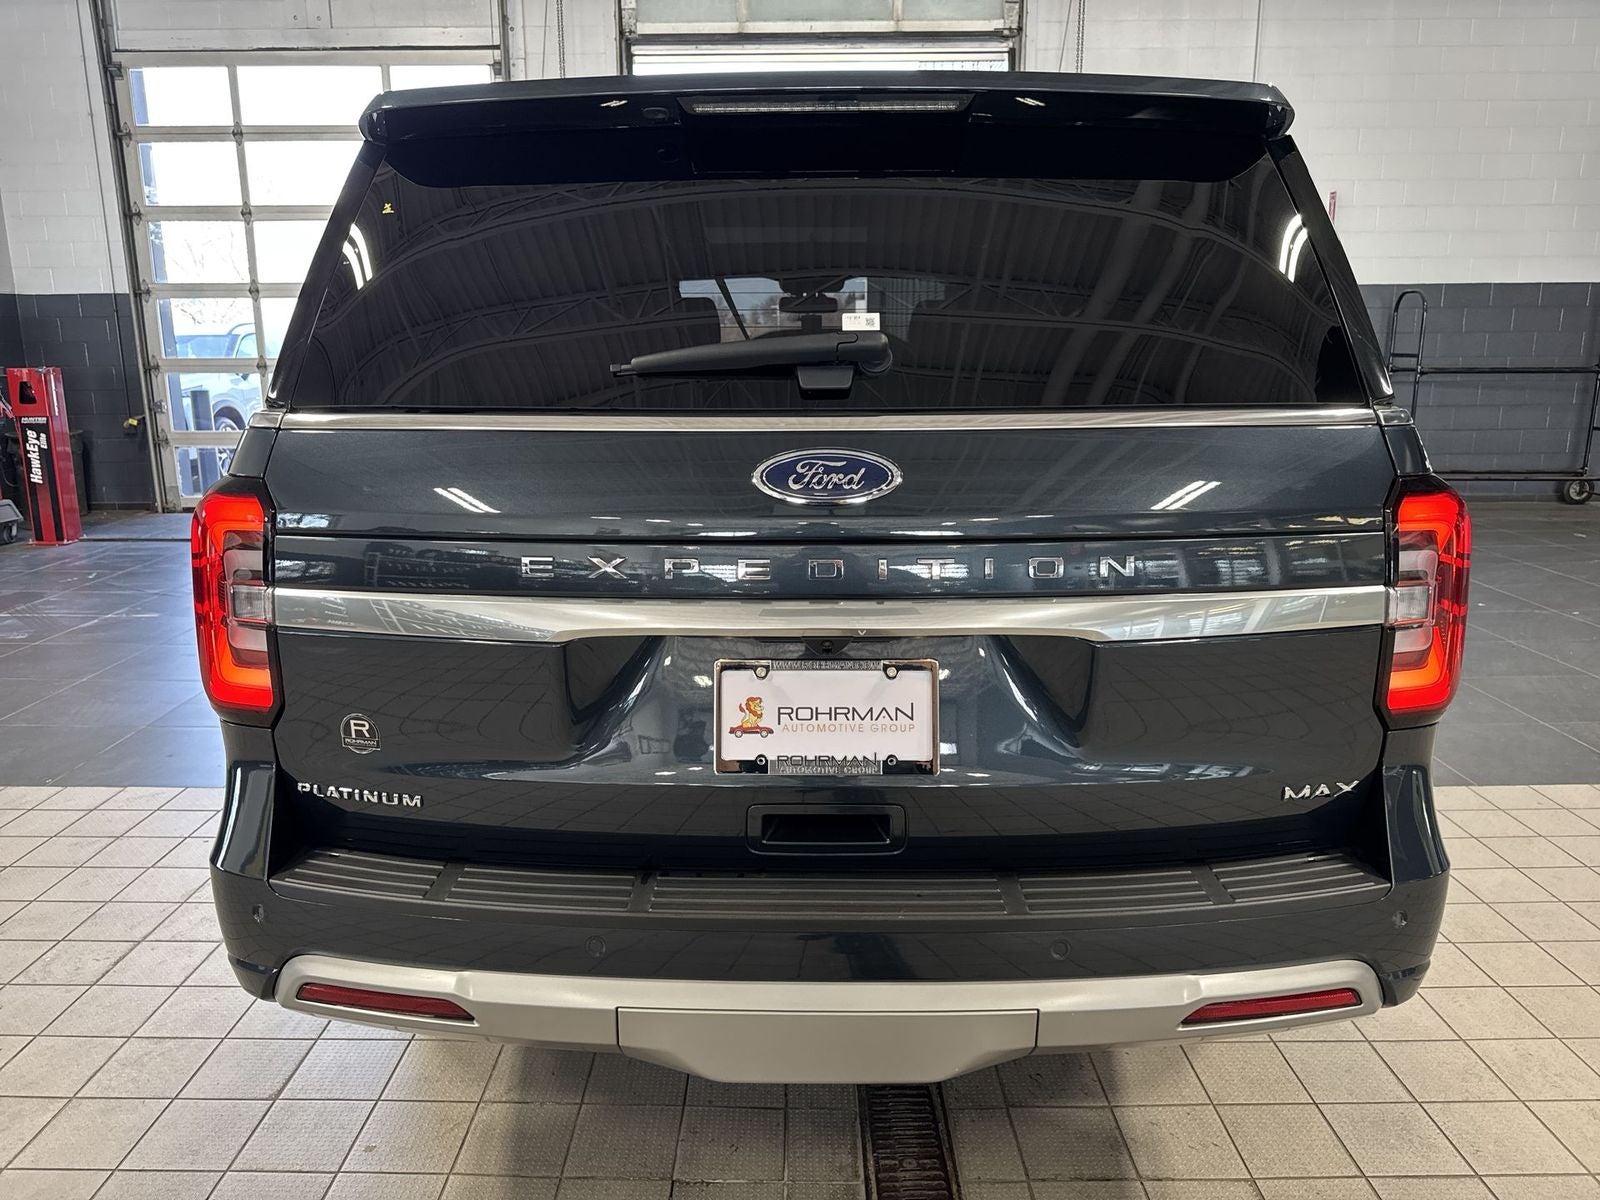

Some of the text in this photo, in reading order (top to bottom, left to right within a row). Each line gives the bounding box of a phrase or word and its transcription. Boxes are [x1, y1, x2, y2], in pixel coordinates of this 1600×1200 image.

[26, 429, 43, 484] HawkEye
[788, 459, 866, 490] Ford
[521, 555, 1136, 583] EXPEDITION
[778, 702, 914, 725] ROHRMAN
[349, 719, 370, 738] R
[782, 723, 916, 732] AUTOMOTIVE GROUP
[776, 752, 878, 768] ROHRMAN
[297, 782, 422, 808] PLATINUM
[1282, 780, 1360, 800] MAX
